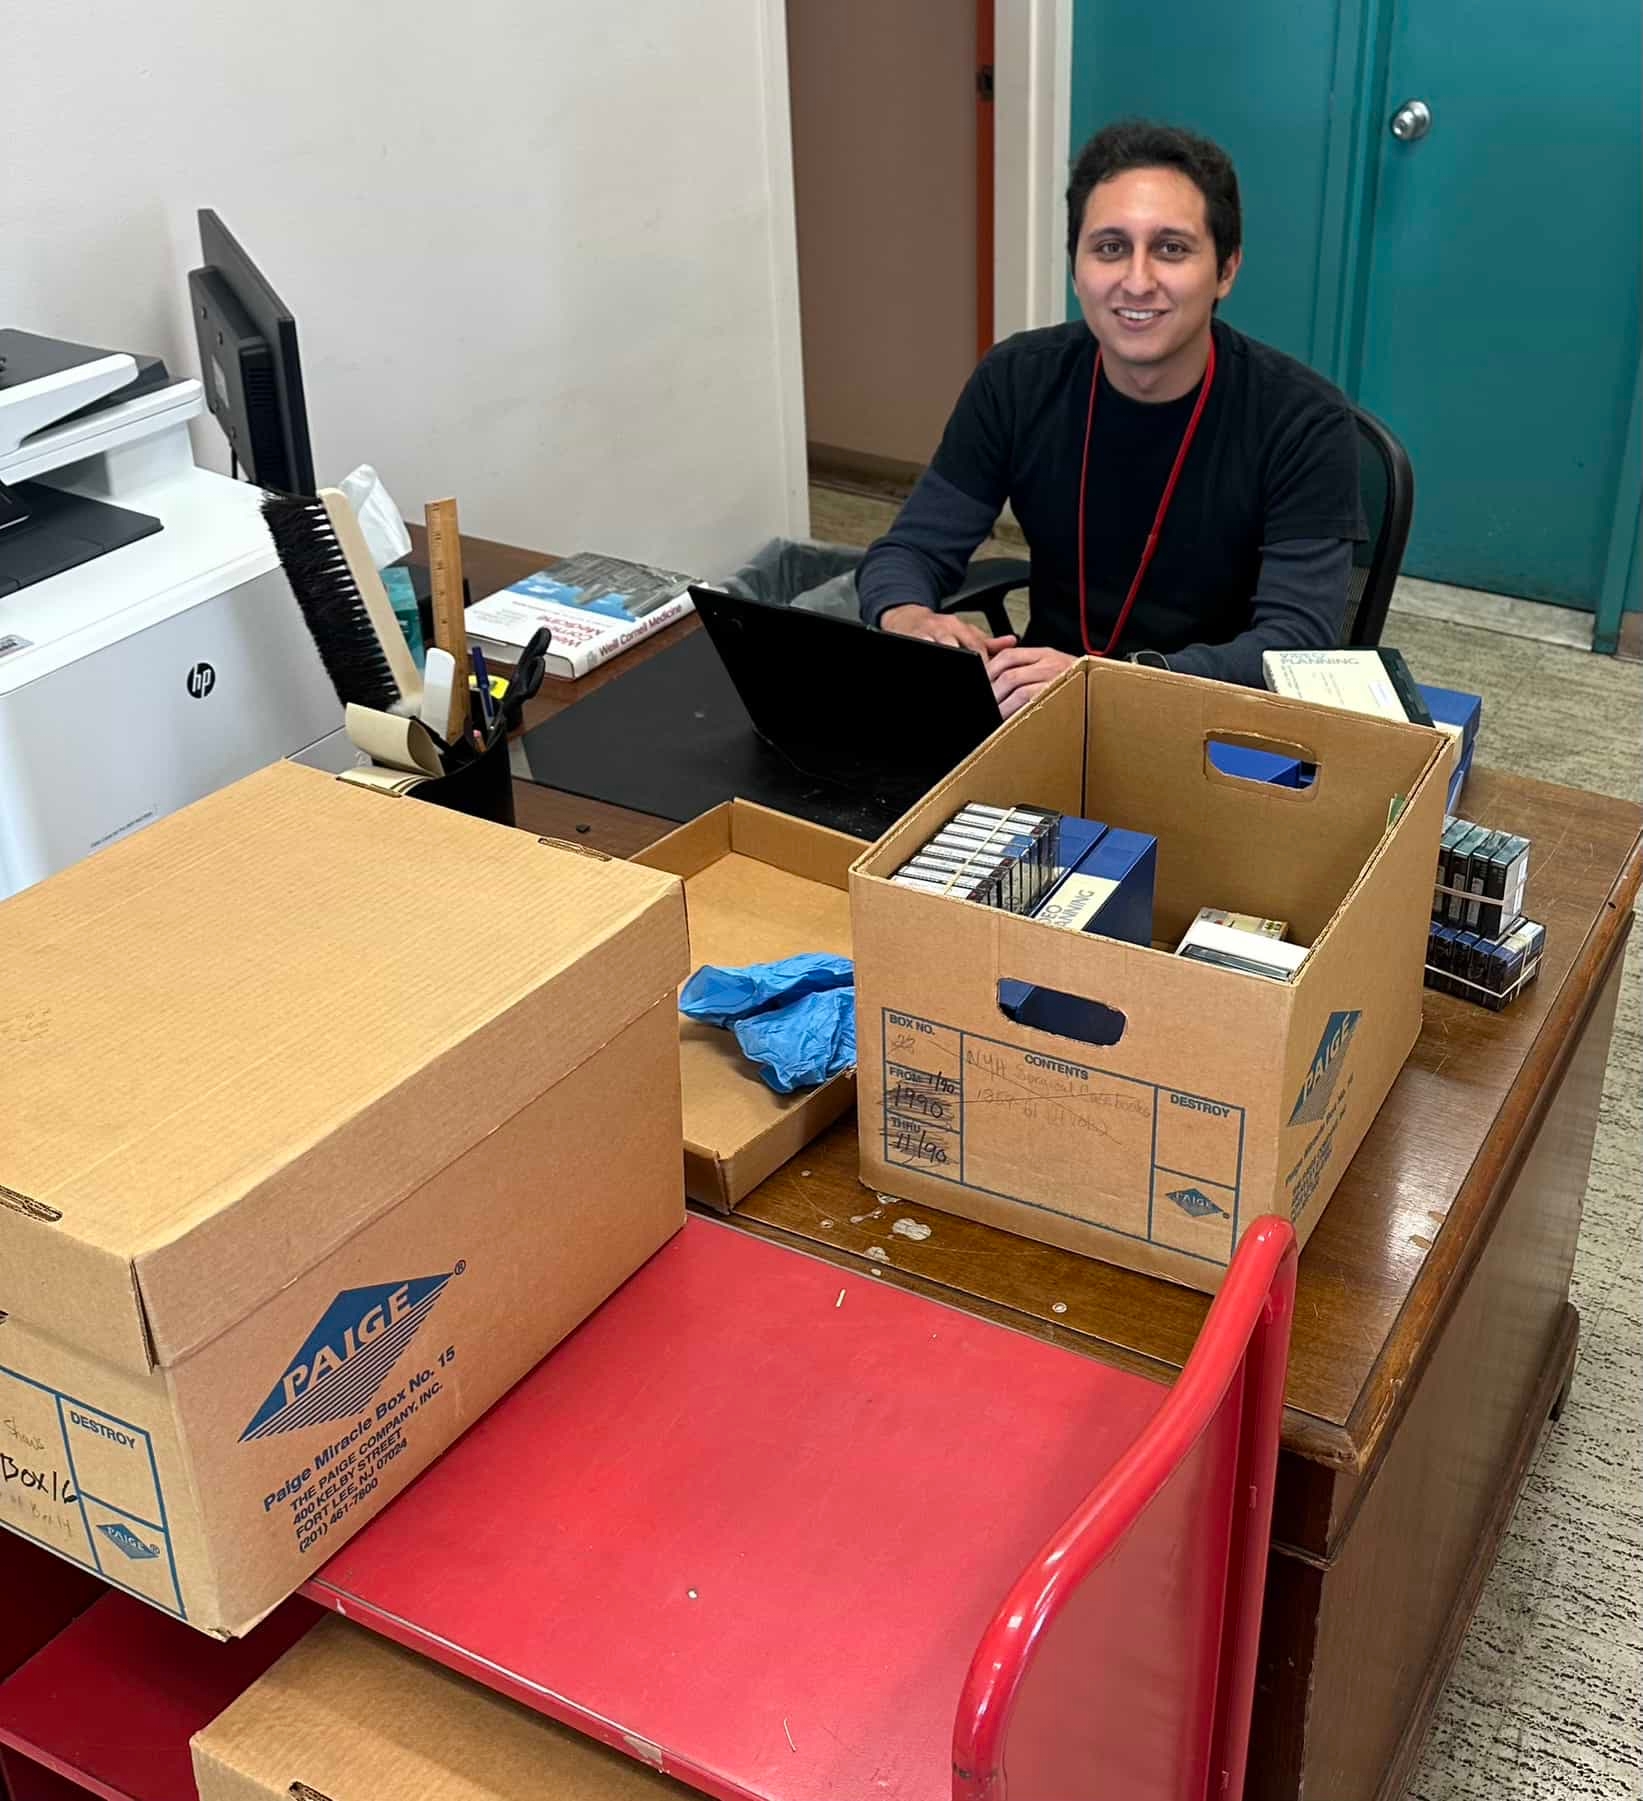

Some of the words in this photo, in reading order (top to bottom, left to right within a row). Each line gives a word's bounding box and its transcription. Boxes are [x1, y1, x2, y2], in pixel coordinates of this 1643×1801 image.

[599, 637, 619, 656] Weill
[620, 621, 648, 645] Cornell
[648, 604, 682, 627] Medicine
[1280, 657, 1360, 665] PLANNING
[191, 663, 212, 699] hp
[1055, 889, 1095, 927] ANNING
[889, 1014, 913, 1030] BOX
[915, 1021, 936, 1036] NO.
[889, 1066, 920, 1083] FROM
[1024, 1053, 1089, 1080] CONTENTS
[1302, 1013, 1350, 1104] PAIGE
[894, 1084, 943, 1118] 1990
[1170, 1094, 1230, 1118] DESTROY
[890, 1116, 921, 1133] THRU
[282, 1284, 412, 1407] PAIGE
[70, 1410, 136, 1448] DESTROY
[264, 1467, 312, 1512] Paige
[314, 1418, 372, 1470] Miracle
[375, 1389, 406, 1420] Box
[409, 1369, 434, 1393] No.
[438, 1345, 456, 1367] 15
[290, 1485, 317, 1511] THE
[319, 1452, 357, 1489] PAIGE
[359, 1401, 419, 1455] COMPANY,
[419, 1381, 443, 1405] INC.
[294, 1502, 315, 1525] 400
[317, 1466, 355, 1507] KELBY
[358, 1427, 402, 1471] STREET
[296, 1503, 330, 1539] FORT
[359, 1466, 375, 1485] NJ
[299, 1522, 328, 1553] (201)
[330, 1478, 378, 1525] 461-7800
[106, 1526, 146, 1552] PAIGE
